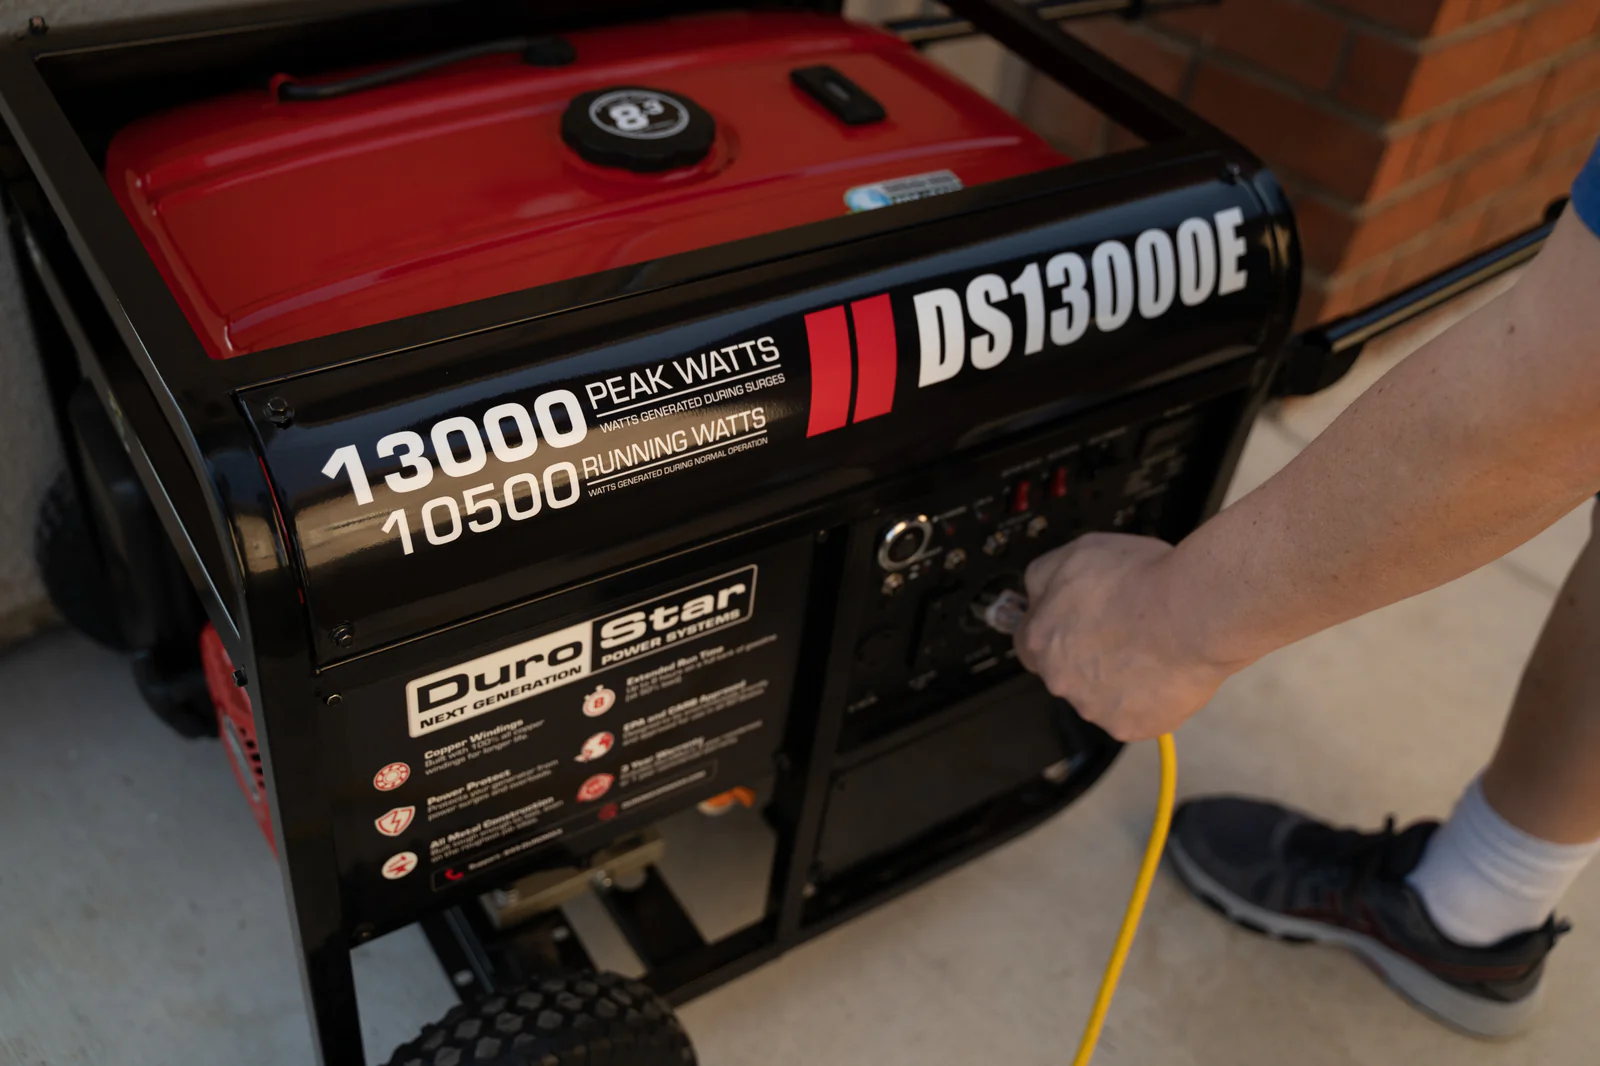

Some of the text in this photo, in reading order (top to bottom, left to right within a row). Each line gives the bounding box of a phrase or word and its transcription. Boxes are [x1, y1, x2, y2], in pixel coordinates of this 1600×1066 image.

[913, 206, 1248, 388] DS13000E
[321, 336, 780, 506] 13000 PEAK WATTS
[600, 373, 786, 434] WATTS GENERATED DURING SURGES
[381, 406, 767, 556] 10500 RUNNING WATTS
[588, 437, 768, 497] WATTS GENERATED DURING NORMAL OPERATION
[601, 608, 741, 666] POWER SYSTEMS
[420, 705, 467, 729] NEXT
[473, 664, 583, 711] GENERATION
[424, 718, 524, 760] Copper Windings
[448, 747, 469, 760] with
[426, 768, 512, 806] Power Protect
[429, 836, 446, 850] All
